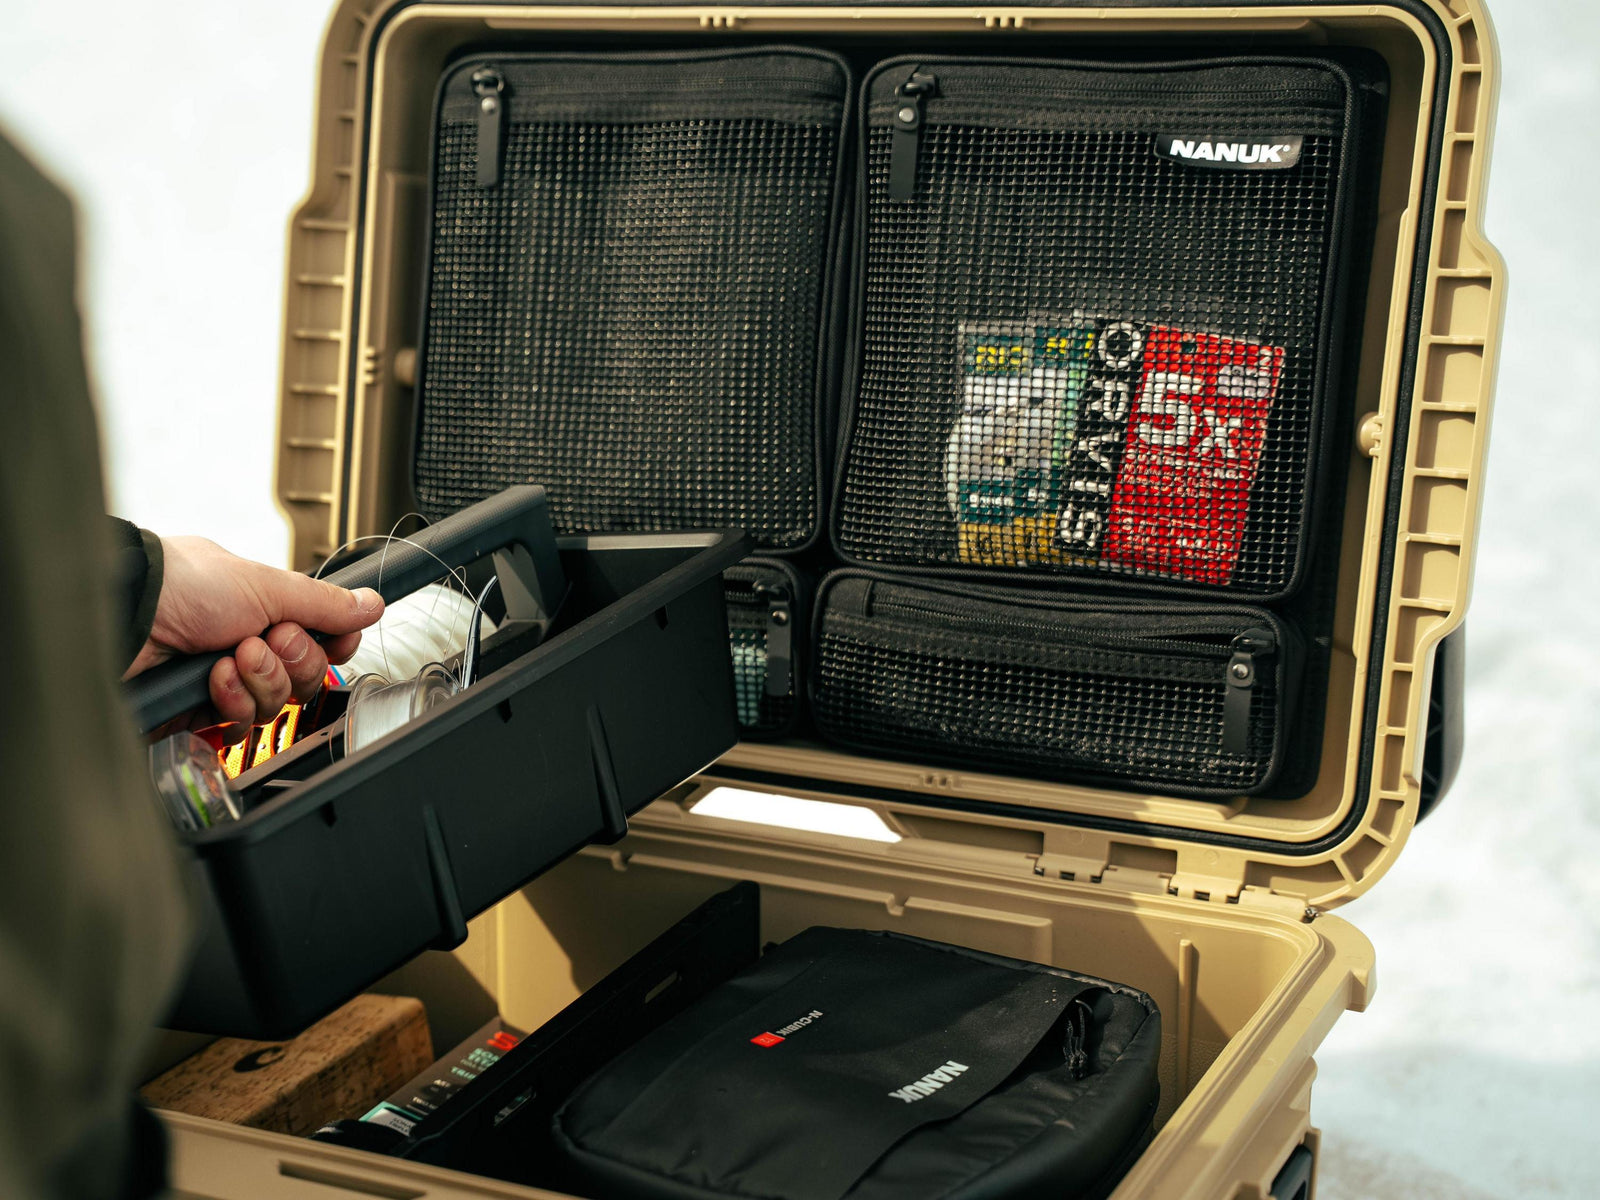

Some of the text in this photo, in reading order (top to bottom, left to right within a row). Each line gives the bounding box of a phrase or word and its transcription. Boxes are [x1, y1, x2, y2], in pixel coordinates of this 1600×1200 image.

[1170, 139, 1284, 164] NANUK
[1059, 321, 1143, 548] ORVIS
[888, 1060, 970, 1103] NANUK
